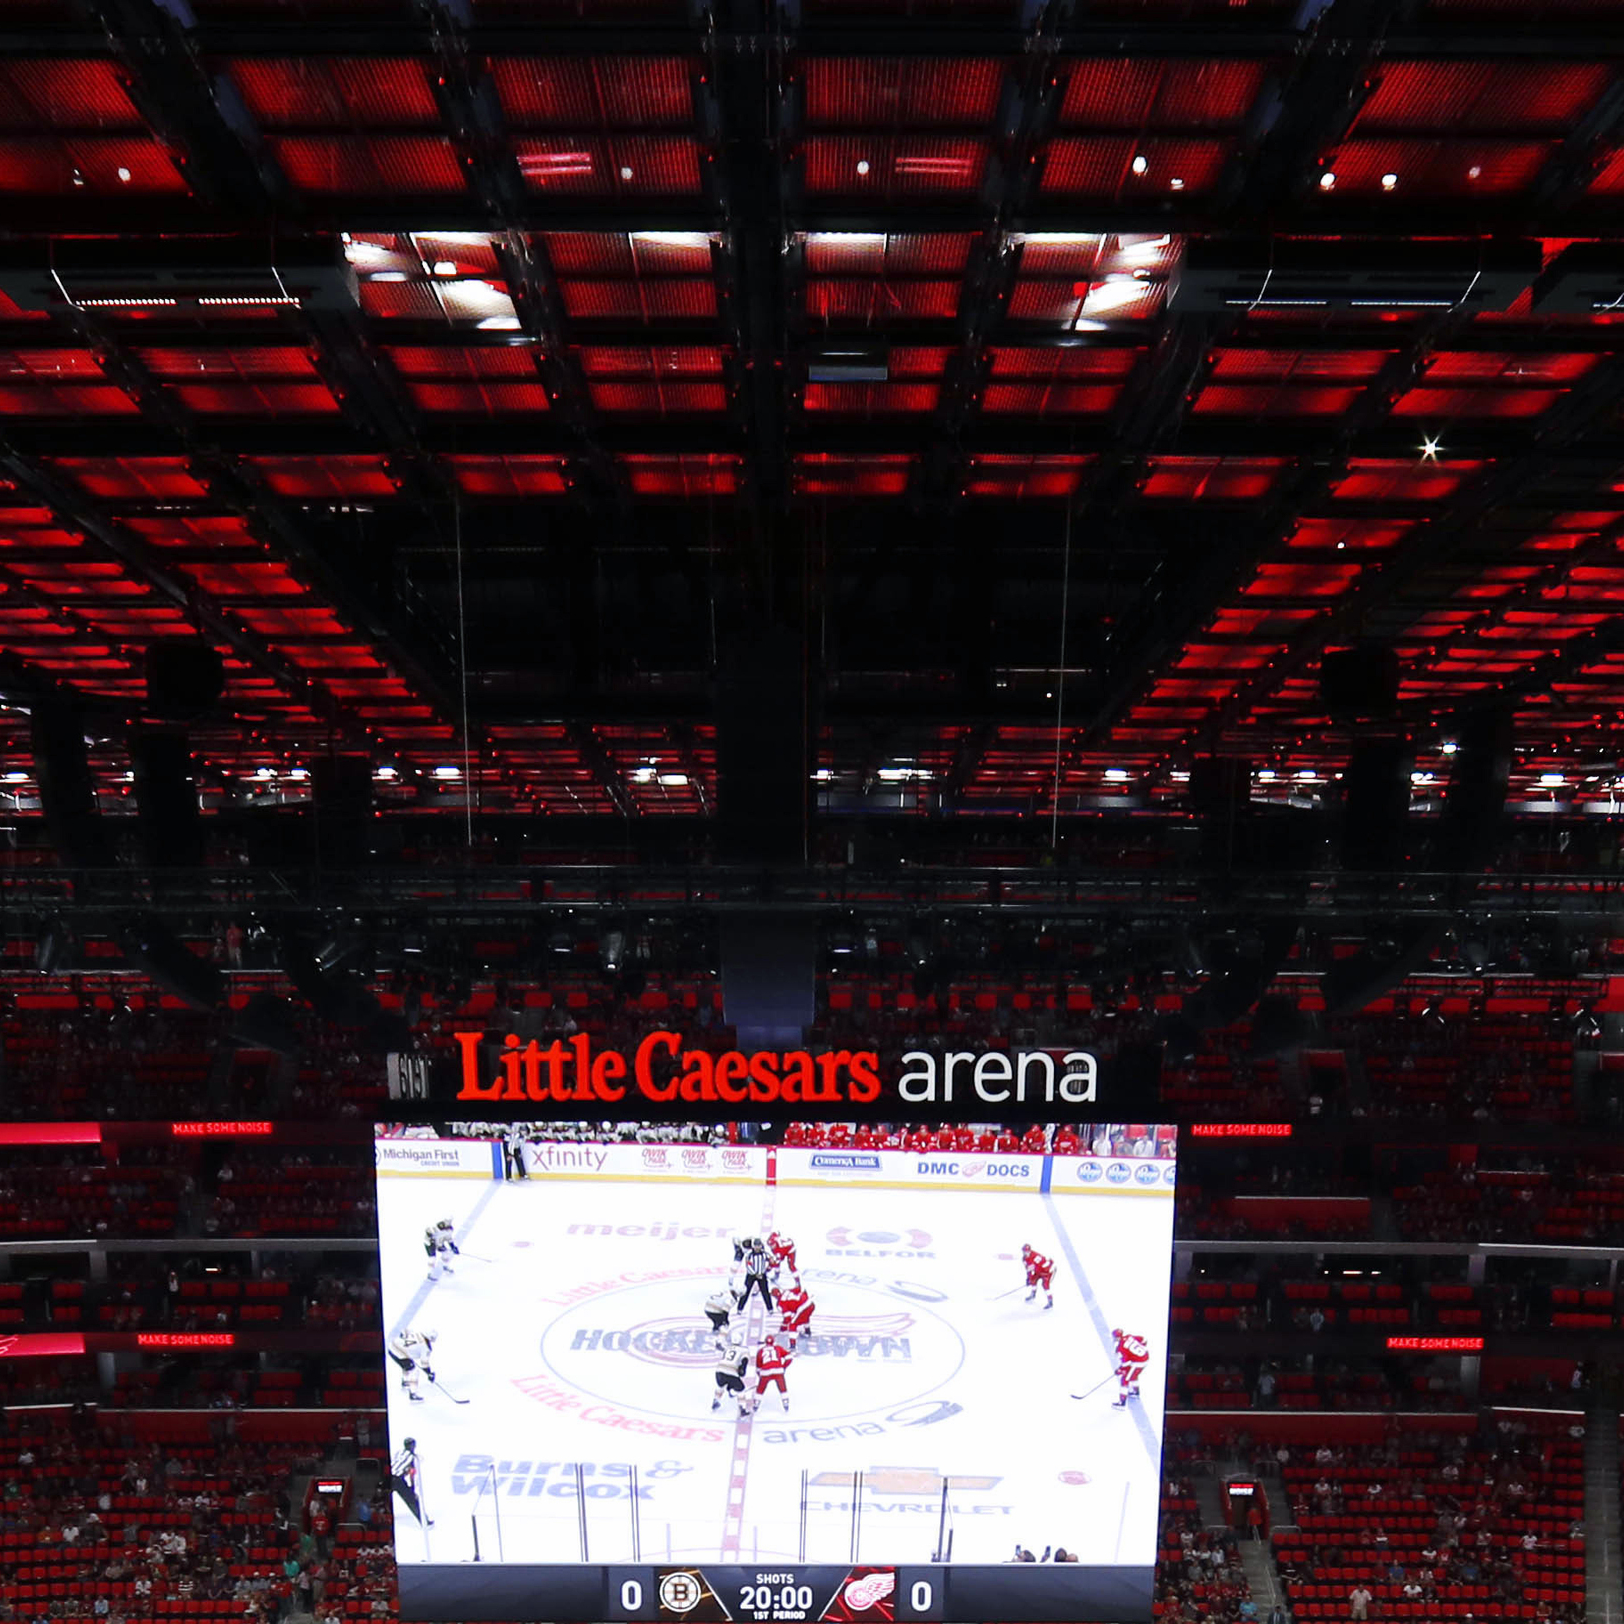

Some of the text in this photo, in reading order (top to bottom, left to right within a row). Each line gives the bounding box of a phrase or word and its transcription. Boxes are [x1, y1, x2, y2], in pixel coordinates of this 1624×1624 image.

[454, 1031, 627, 1100] Little
[635, 1030, 882, 1101] Caesars
[898, 1050, 1097, 1102] arena
[173, 1123, 204, 1133] MAKE
[238, 1122, 270, 1132] NOISE
[1193, 1124, 1291, 1135] MAKE SOME NOISE
[383, 1149, 458, 1161] Michigan First
[532, 1146, 608, 1170] xfinity
[918, 1162, 1030, 1178] DMC DOCS
[566, 1222, 736, 1241] meijer
[825, 1249, 936, 1260] BELFOR
[801, 1266, 877, 1286] rena
[138, 1334, 169, 1345] MAKE
[201, 1334, 234, 1344] NOISE
[1388, 1338, 1419, 1348] MAKE
[1420, 1338, 1449, 1348] SOME
[579, 1397, 724, 1443] Caesars
[763, 1422, 887, 1445] arena
[452, 1454, 694, 1480] Burns &
[451, 1475, 656, 1501] Wilcox
[801, 1501, 1015, 1515] CHEVROLET
[756, 1573, 794, 1584] SHOTS
[621, 1580, 642, 1610] 0
[673, 1584, 689, 1601] B
[739, 1587, 813, 1610] 20:00
[911, 1580, 932, 1611] 0
[753, 1611, 805, 1620] 1ST PERIOD
